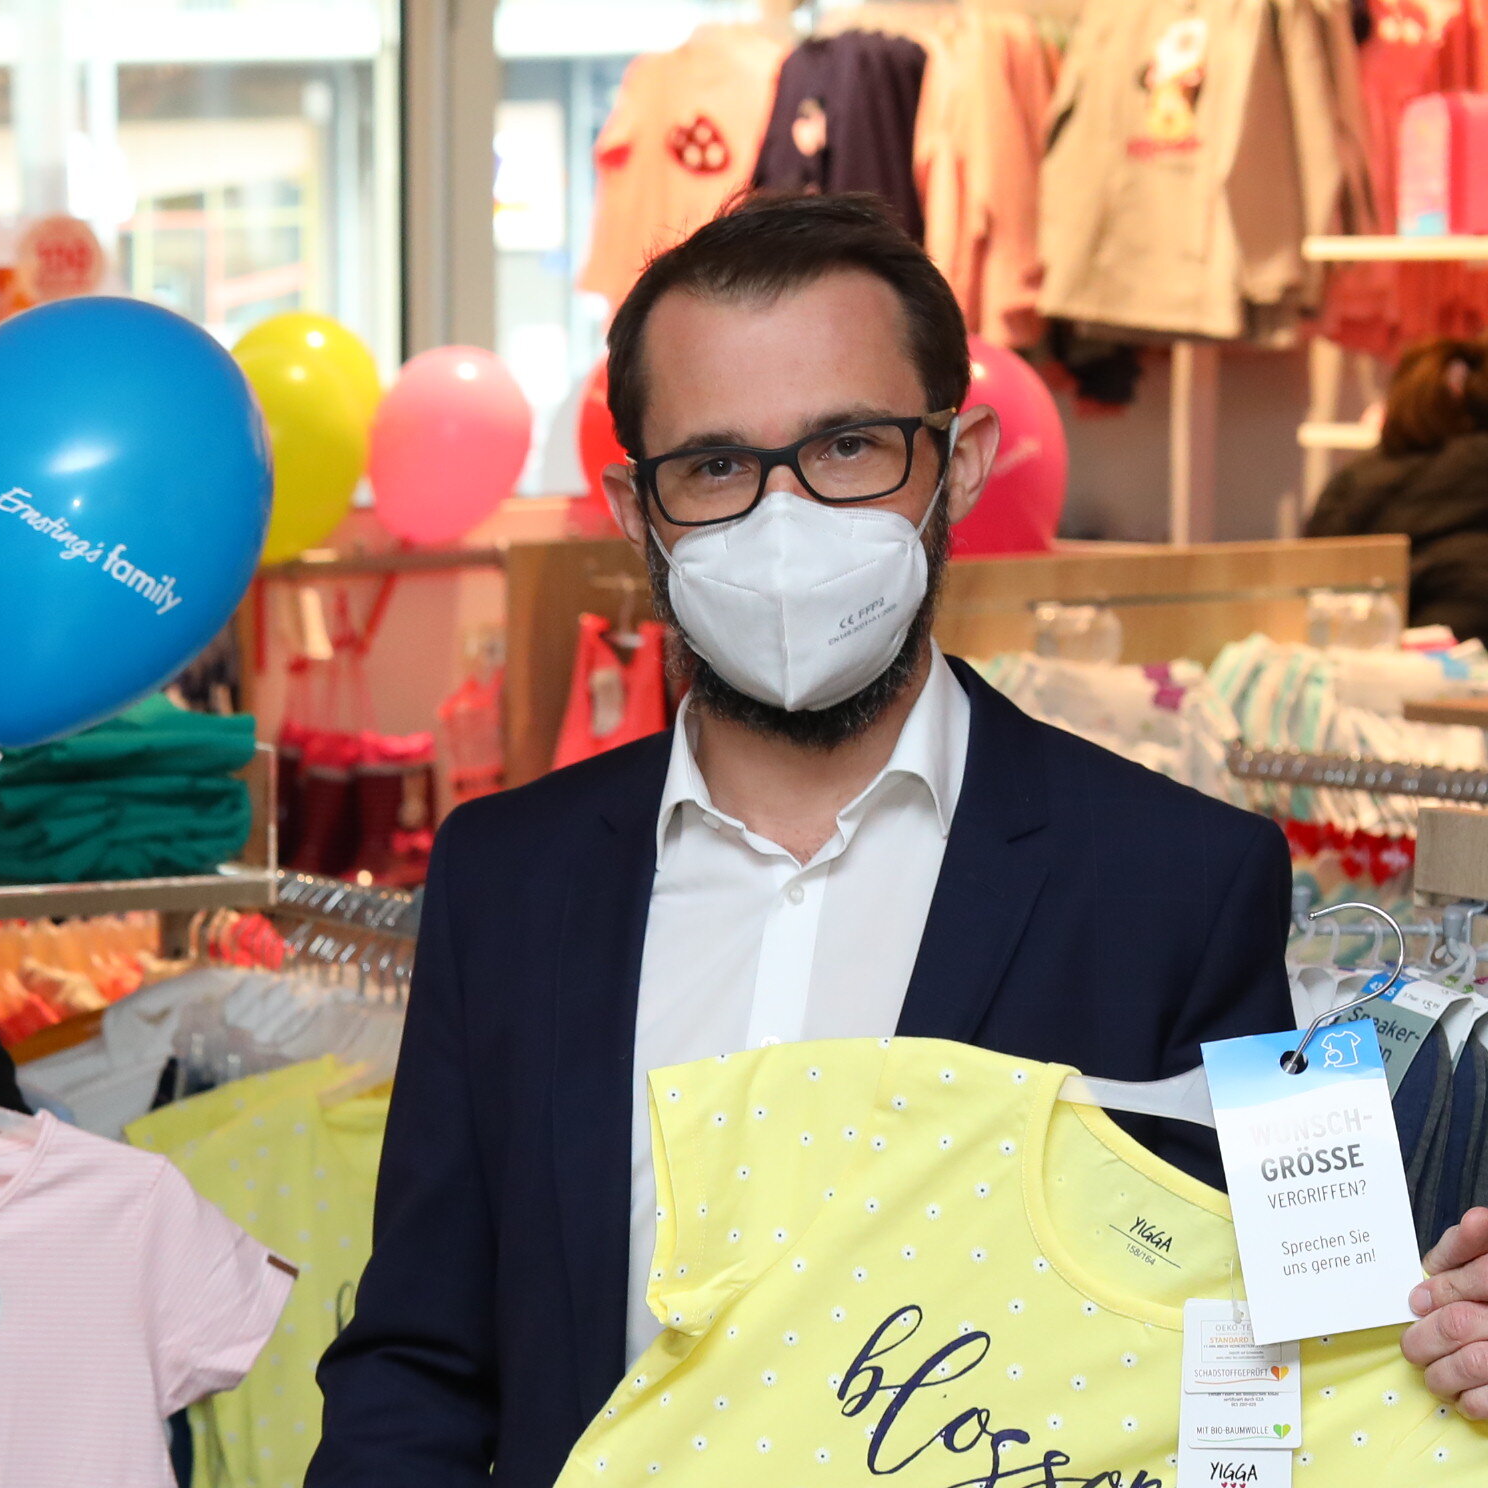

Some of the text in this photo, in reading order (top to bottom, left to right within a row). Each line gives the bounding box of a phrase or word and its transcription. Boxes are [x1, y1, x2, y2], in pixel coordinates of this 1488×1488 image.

[102, 543, 183, 616] family
[1260, 1143, 1364, 1182] GRÖSSE
[1267, 1179, 1367, 1210] VERGRIFFEN?
[1129, 1216, 1173, 1253] YIGGA
[1281, 1229, 1370, 1257] Sprechen Sie
[1126, 1243, 1156, 1265] 158/164
[1283, 1248, 1377, 1276] uns gerne an!
[1209, 1336, 1249, 1344] STANDARD
[1215, 1324, 1253, 1332] OEKO-TE
[1194, 1368, 1268, 1378] SCHADSTOFFGEPRÜFT
[1196, 1426, 1269, 1435] MIT BIO-BAUMWOLLE
[1210, 1461, 1258, 1482] YIGGA
